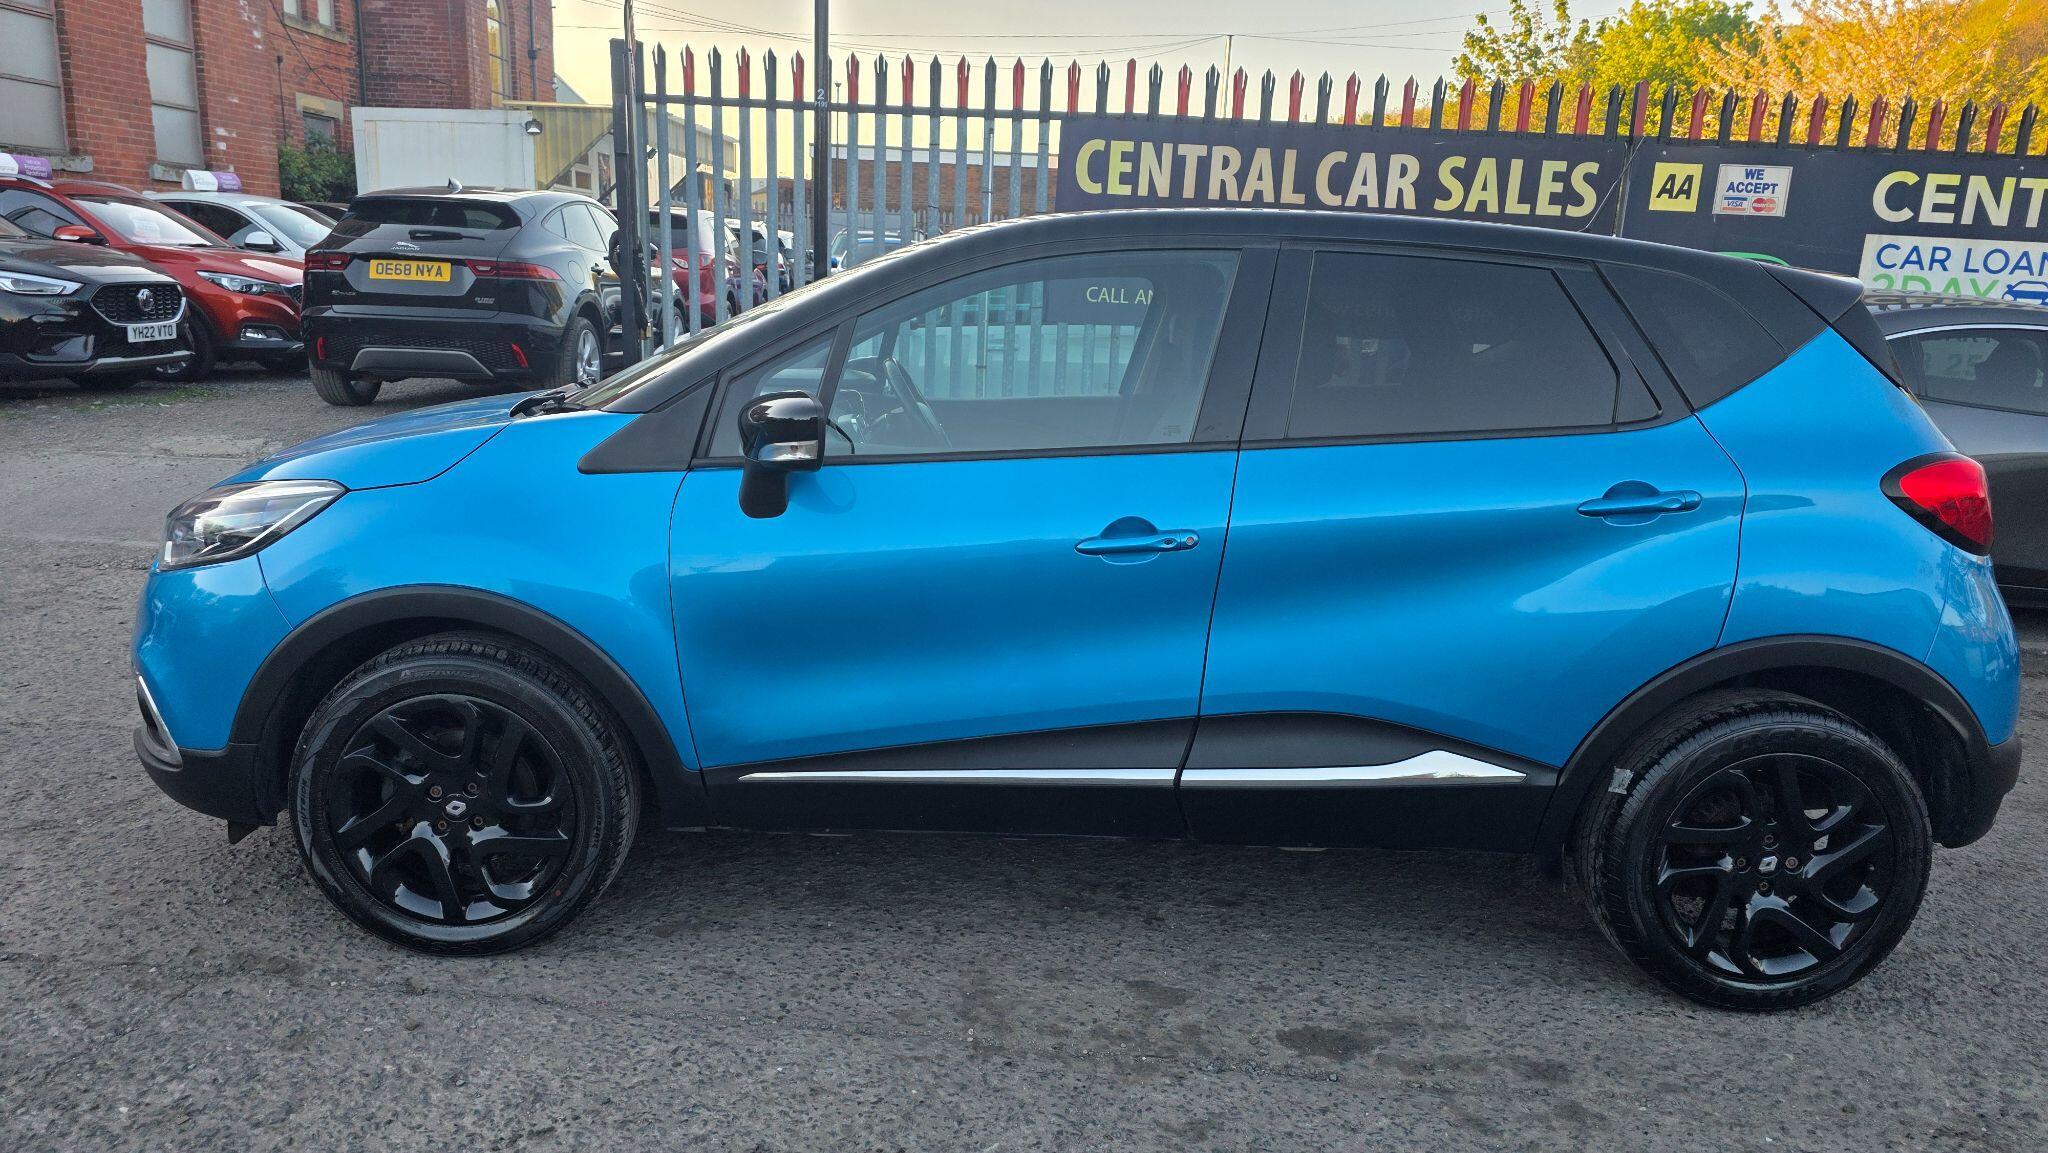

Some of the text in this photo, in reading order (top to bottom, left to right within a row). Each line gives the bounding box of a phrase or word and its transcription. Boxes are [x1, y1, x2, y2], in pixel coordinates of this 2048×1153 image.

[817, 88, 825, 100] 2
[1075, 138, 1600, 218] CENTRAL CAR SALES
[1745, 168, 1765, 180] WE
[1656, 173, 1694, 200] AA
[1726, 182, 1778, 194] ACCEPT
[1872, 170, 2048, 228] CENT
[1875, 243, 1952, 272] CAR
[375, 262, 443, 277] OE68 NYA
[1086, 286, 1129, 304] CALL
[132, 322, 174, 339] YH22 VTO
